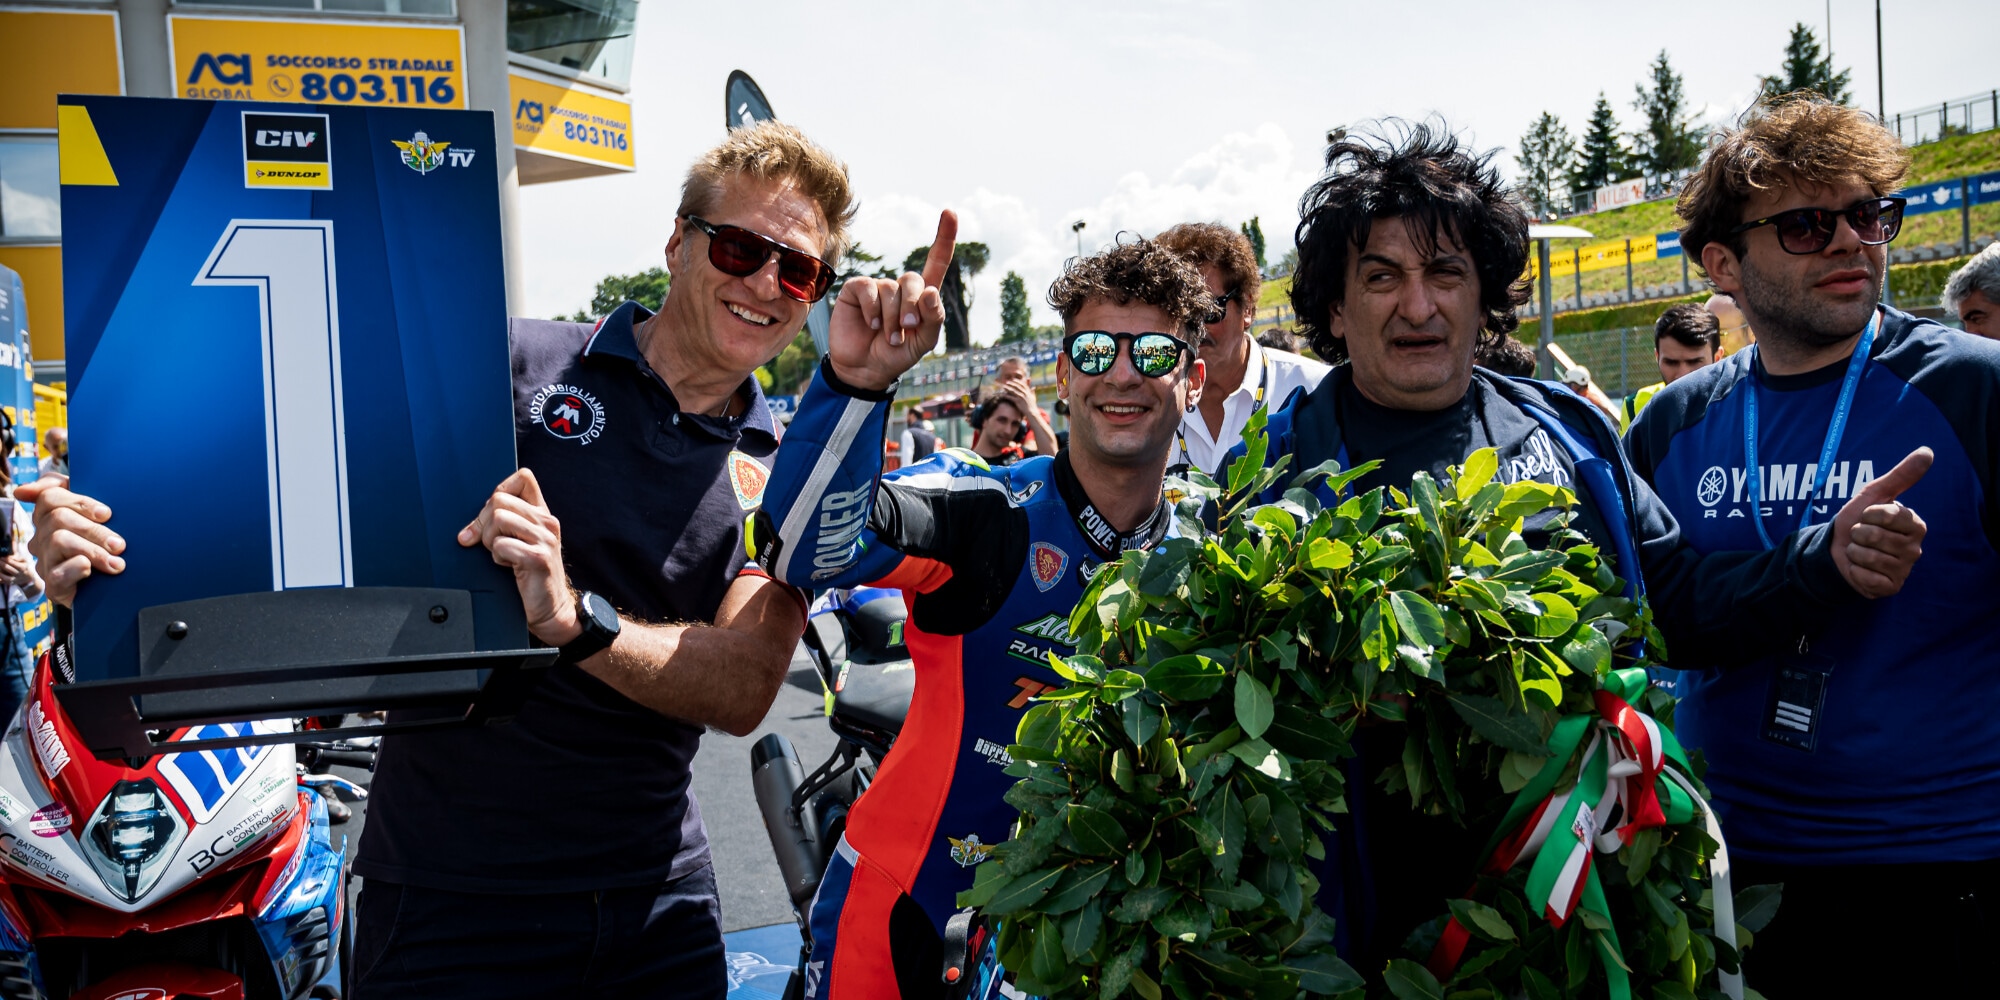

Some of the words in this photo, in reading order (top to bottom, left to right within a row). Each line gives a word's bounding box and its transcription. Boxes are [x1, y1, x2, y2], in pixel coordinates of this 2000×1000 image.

[266, 54, 362, 70] SOCCORSO
[368, 57, 454, 73] STRADALE
[187, 87, 253, 100] GLOBAL
[300, 72, 456, 104] 803.116
[266, 170, 321, 179] DUNLOP
[449, 153, 476, 168] TV
[192, 218, 354, 591] 1
[530, 384, 606, 446] MOTOABBIGLIAMENTO.IT
[1704, 505, 1829, 519] RACIN
[1079, 504, 1117, 552] POWE
[35, 820, 62, 828] ROUND
[63, 816, 69, 825] 2
[232, 803, 287, 844] CONTROLLER
[16, 838, 57, 863] BATTERY
[187, 834, 234, 875] BC
[226, 808, 265, 837] BATTERY
[11, 847, 71, 882] CONTROLLER
